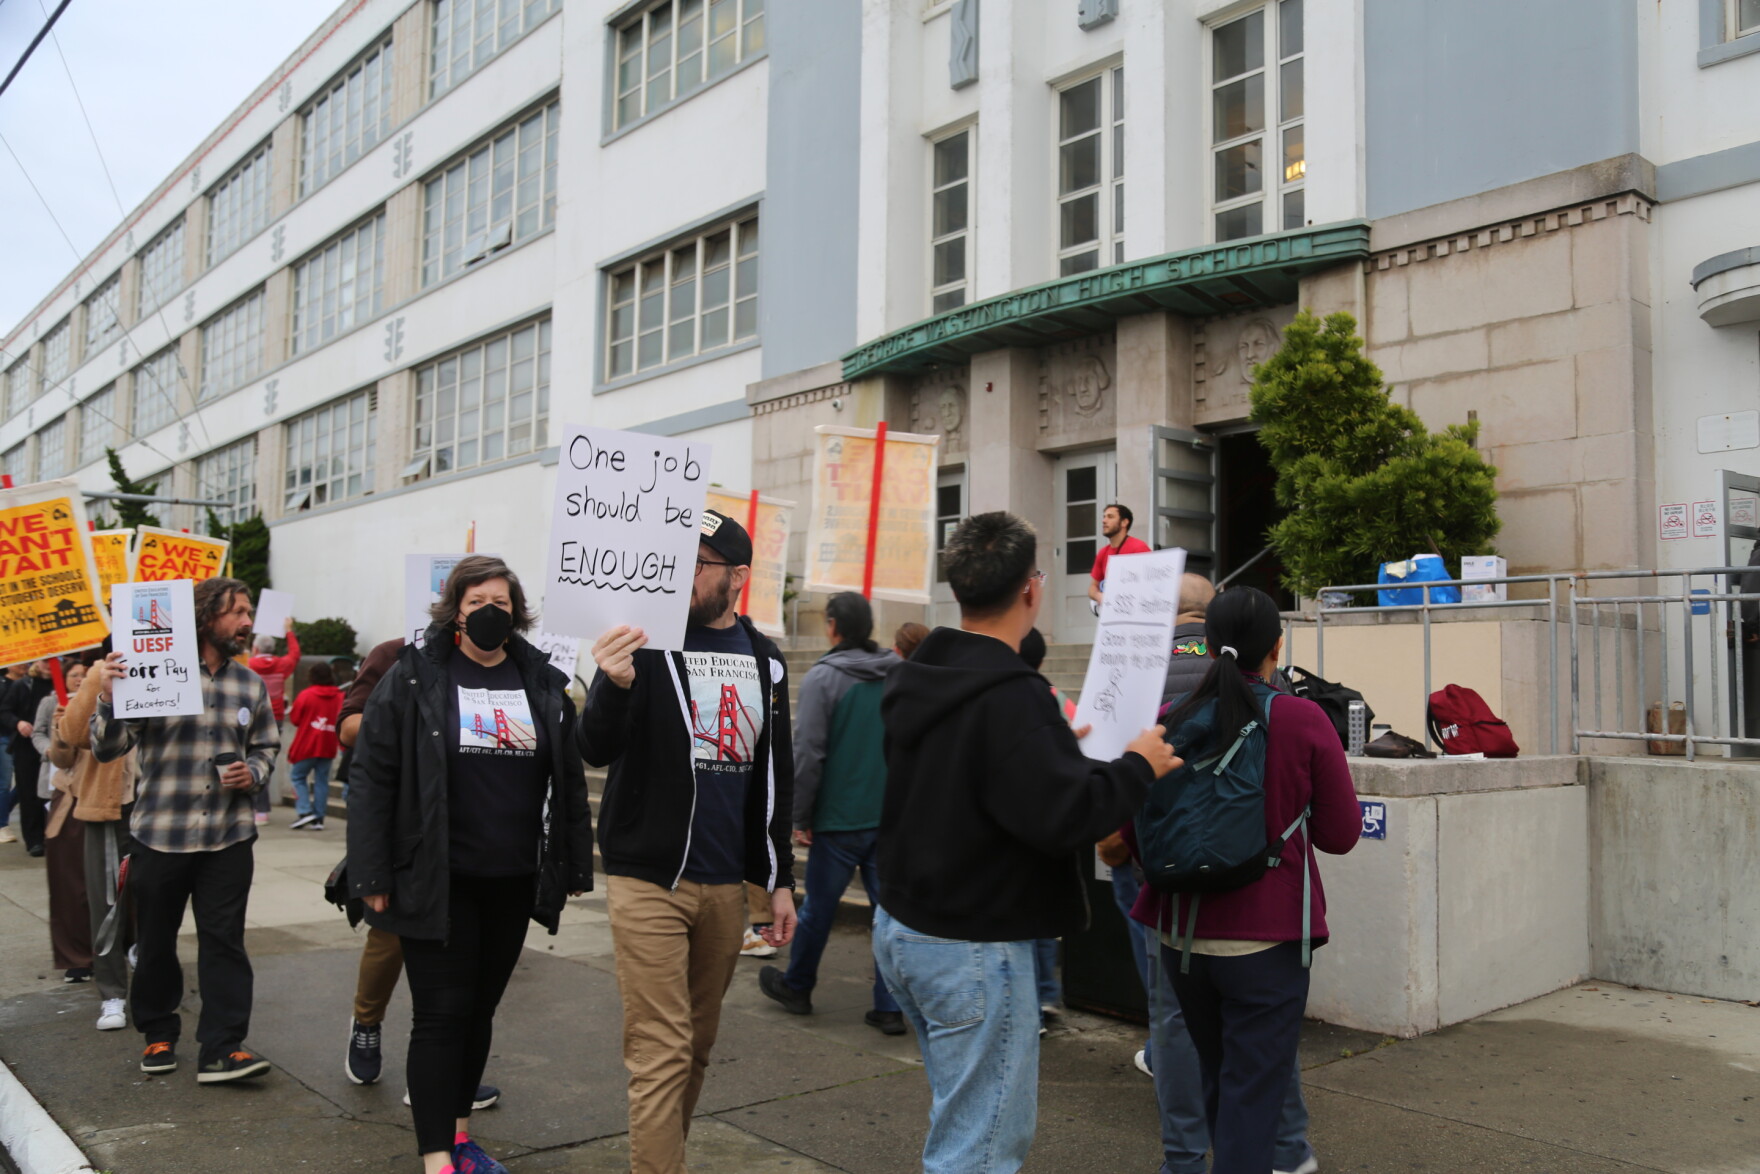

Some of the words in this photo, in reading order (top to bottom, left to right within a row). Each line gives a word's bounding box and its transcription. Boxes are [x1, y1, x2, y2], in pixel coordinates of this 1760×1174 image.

[855, 331, 915, 367] GEORGE
[922, 285, 1060, 342] WASHINGTON
[1077, 266, 1145, 300] HIGH
[1166, 237, 1306, 281] SCHOOL
[569, 434, 626, 472] One
[639, 447, 701, 493] job
[566, 485, 642, 523] should
[664, 496, 693, 528] be
[0, 547, 73, 579] AIT
[162, 542, 203, 563] WE
[561, 541, 676, 581] ENOUGH
[133, 637, 174, 653] UESF
[164, 658, 189, 683] Pay
[146, 683, 162, 692] for
[487, 690, 522, 700] EDUCATORS
[125, 692, 181, 711] Educators!
[487, 698, 523, 707] FRANCISCO
